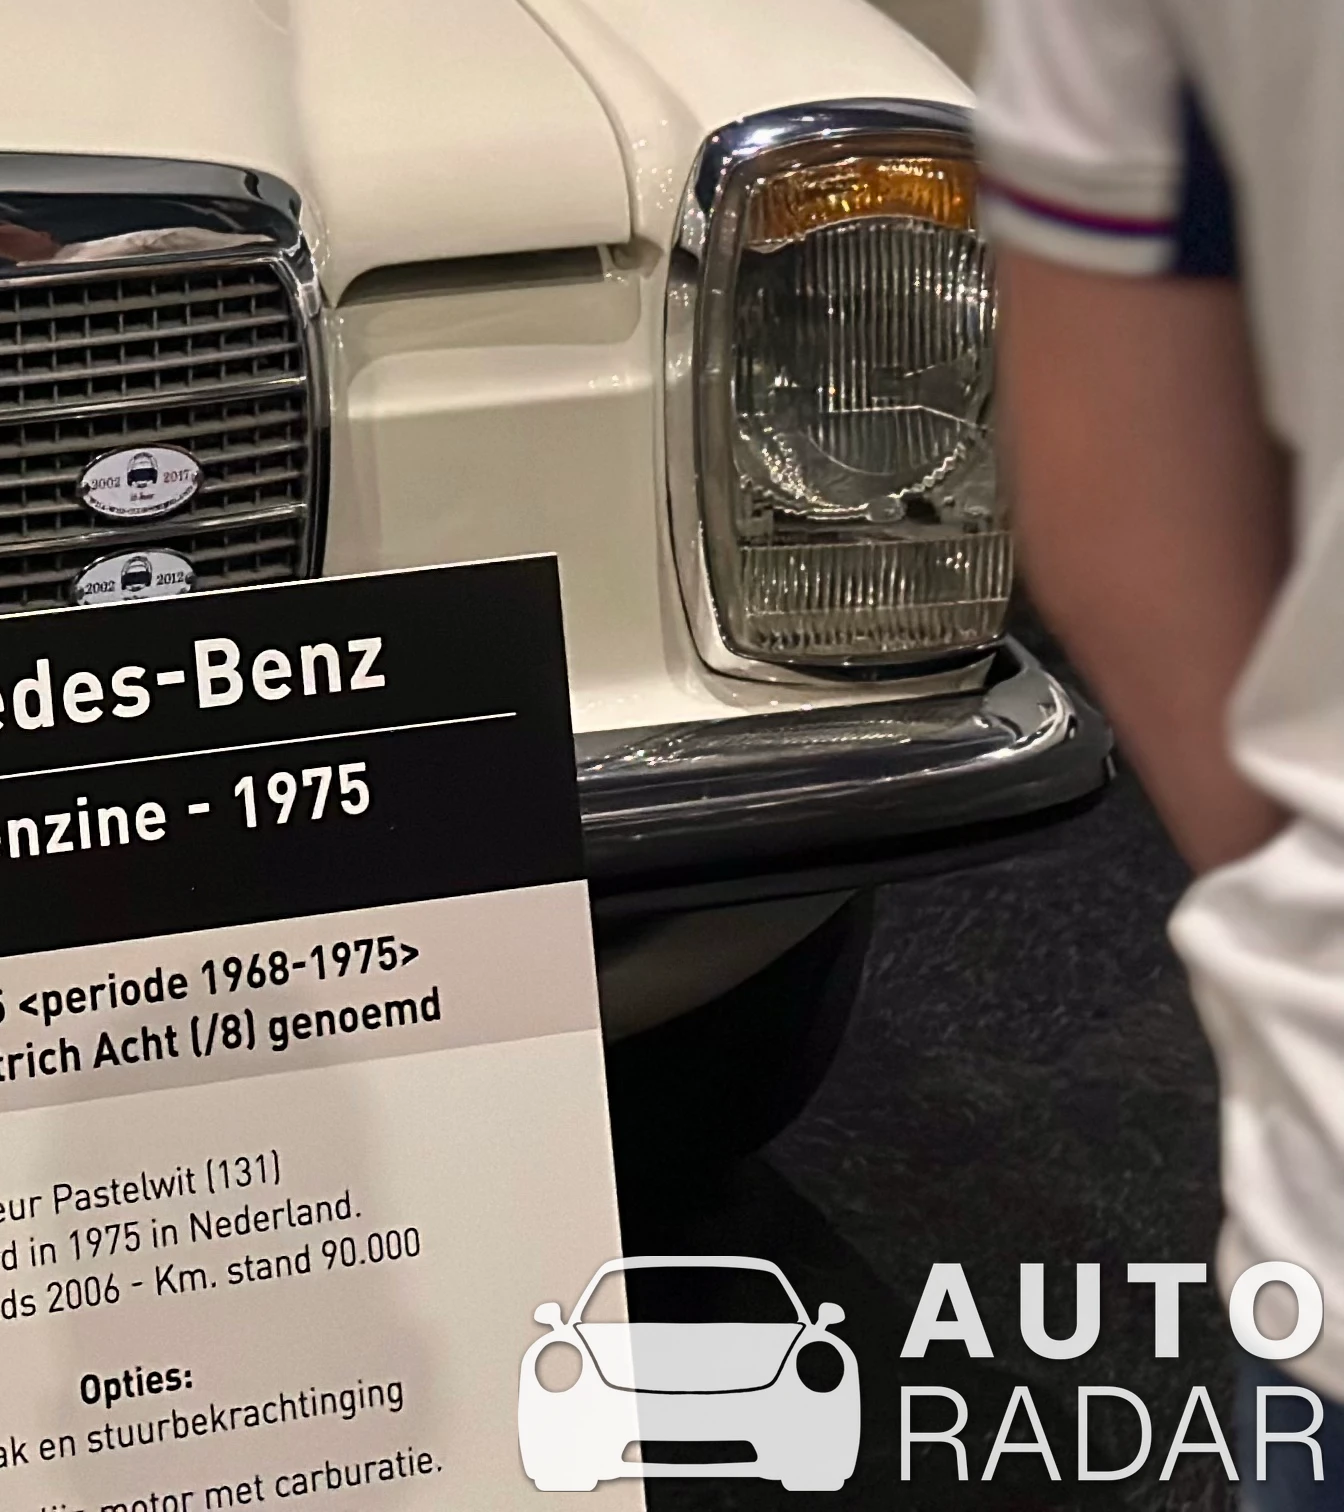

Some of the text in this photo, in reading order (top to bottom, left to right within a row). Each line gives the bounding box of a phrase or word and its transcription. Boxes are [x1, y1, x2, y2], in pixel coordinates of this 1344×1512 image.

[83, 571, 185, 595] 2002 2012
[187, 802, 210, 815] -
[234, 761, 370, 828] 1975
[18, 966, 188, 1027] <periode
[201, 935, 419, 995] 1968-1975>
[92, 1024, 180, 1069] Acht
[190, 1007, 256, 1058] (/8)
[268, 985, 441, 1052] genoemd
[53, 1166, 197, 1215] Pastelwit
[206, 1149, 280, 1195] (131)
[30, 1243, 57, 1267] in
[69, 1221, 141, 1261] 1975
[151, 1218, 178, 1248] in
[189, 1189, 361, 1243] Nederland.
[47, 1272, 120, 1314] 2006
[155, 1263, 217, 1296] Km.
[227, 1243, 311, 1285] stand
[321, 1227, 420, 1270] 90.000
[39, 1435, 76, 1461] en
[87, 1381, 404, 1454] stuurbekrachtinging
[80, 1366, 193, 1410] Opties:
[205, 1474, 265, 1510] met
[275, 1446, 442, 1498] carburatie.
